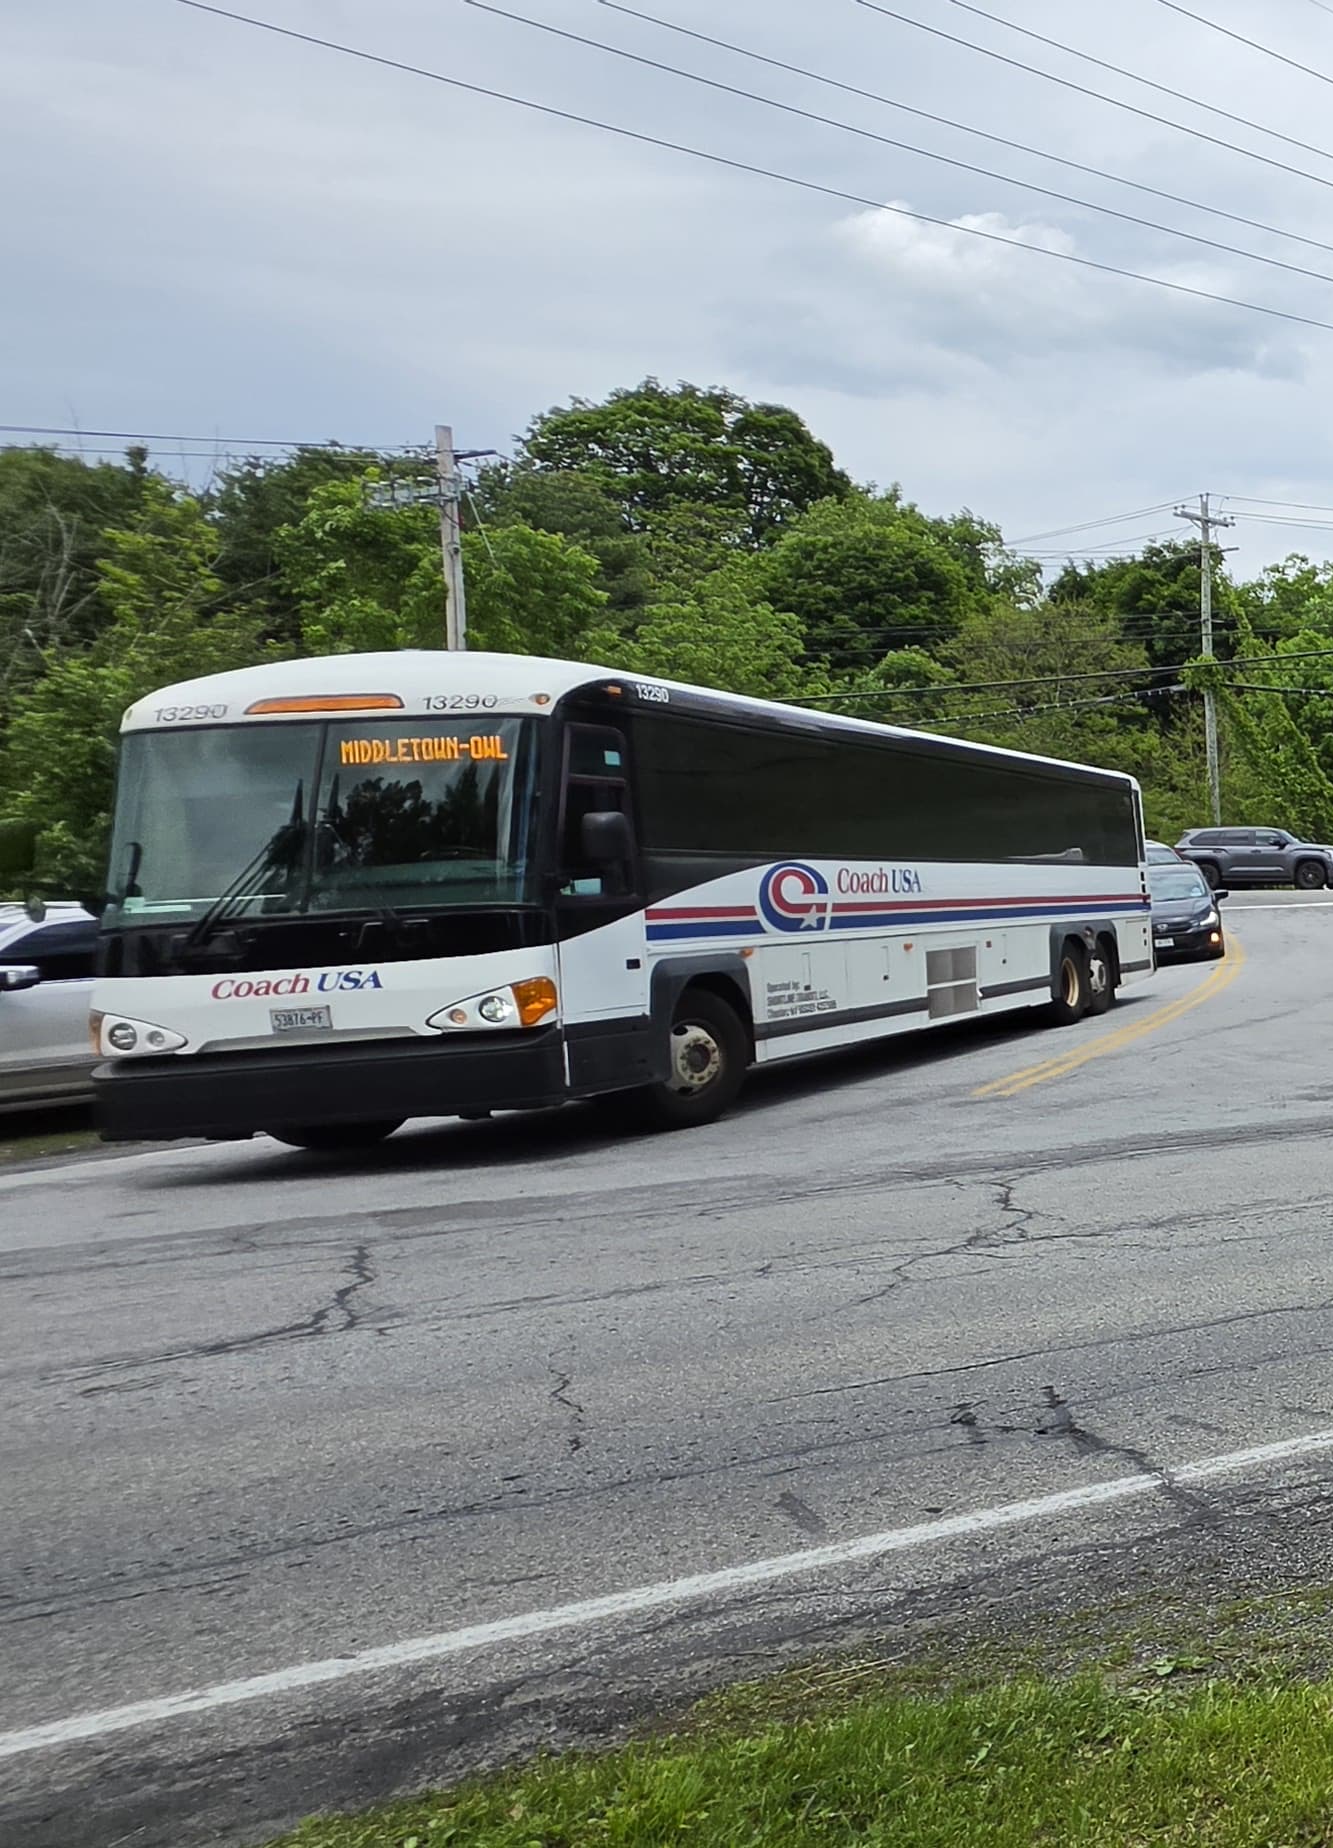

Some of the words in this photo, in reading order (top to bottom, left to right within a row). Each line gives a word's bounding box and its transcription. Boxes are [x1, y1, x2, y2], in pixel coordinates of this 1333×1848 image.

[422, 694, 498, 710] 13290
[635, 683, 669, 703] 13290
[154, 704, 228, 722] 13290
[340, 735, 508, 765] MIDDLETOWN-OWL
[837, 867, 888, 894] Coach
[891, 869, 922, 893] USA
[211, 973, 310, 1000] Coach
[317, 970, 383, 992] USA
